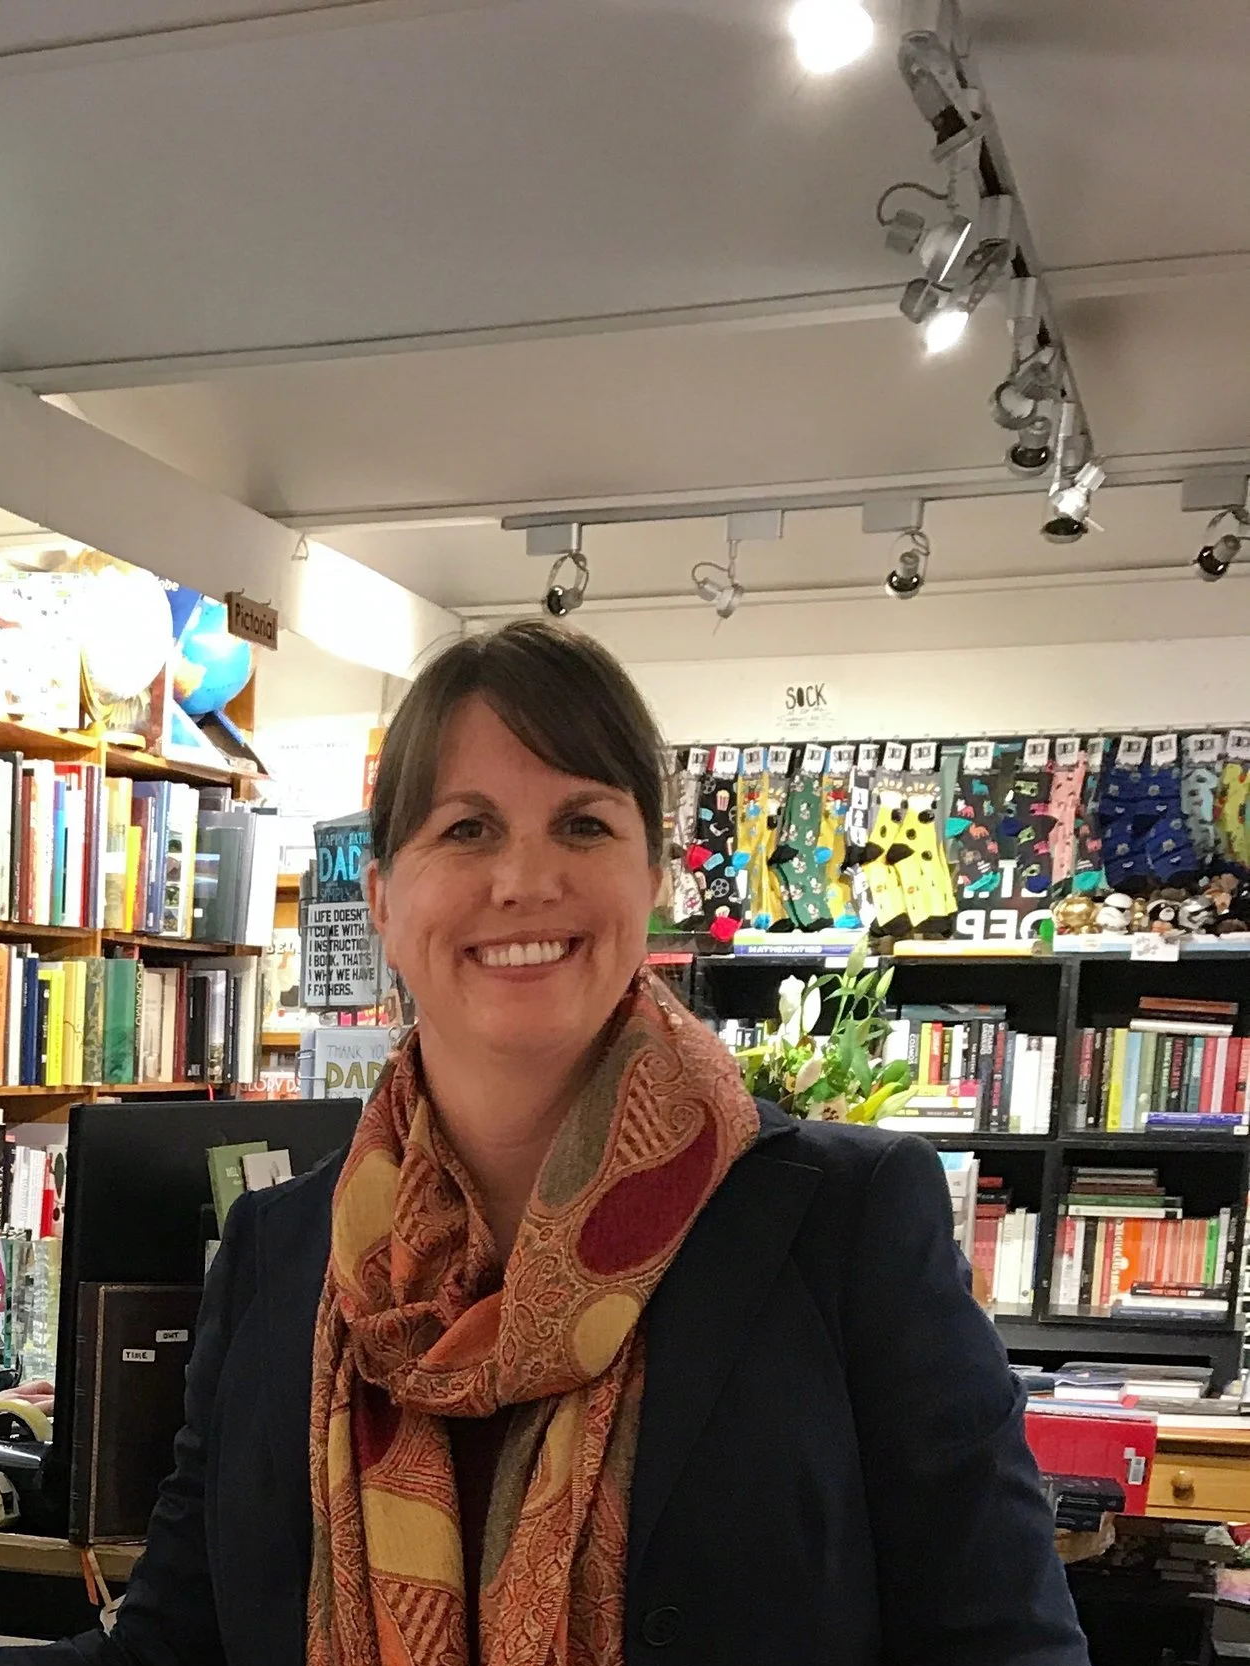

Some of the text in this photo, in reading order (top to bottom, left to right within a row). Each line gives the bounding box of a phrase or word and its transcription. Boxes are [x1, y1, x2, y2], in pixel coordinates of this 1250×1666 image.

[235, 602, 276, 641] Pictorial
[786, 683, 828, 710] SOCK
[318, 846, 362, 883] DAD
[315, 908, 370, 924] LIFE DOESN'T
[315, 924, 365, 937] COME WITH
[342, 953, 372, 966] THAT'S
[314, 968, 375, 982] WHY WE HAVE
[314, 982, 354, 997] FATHERS.
[126, 1351, 148, 1360] TIME
